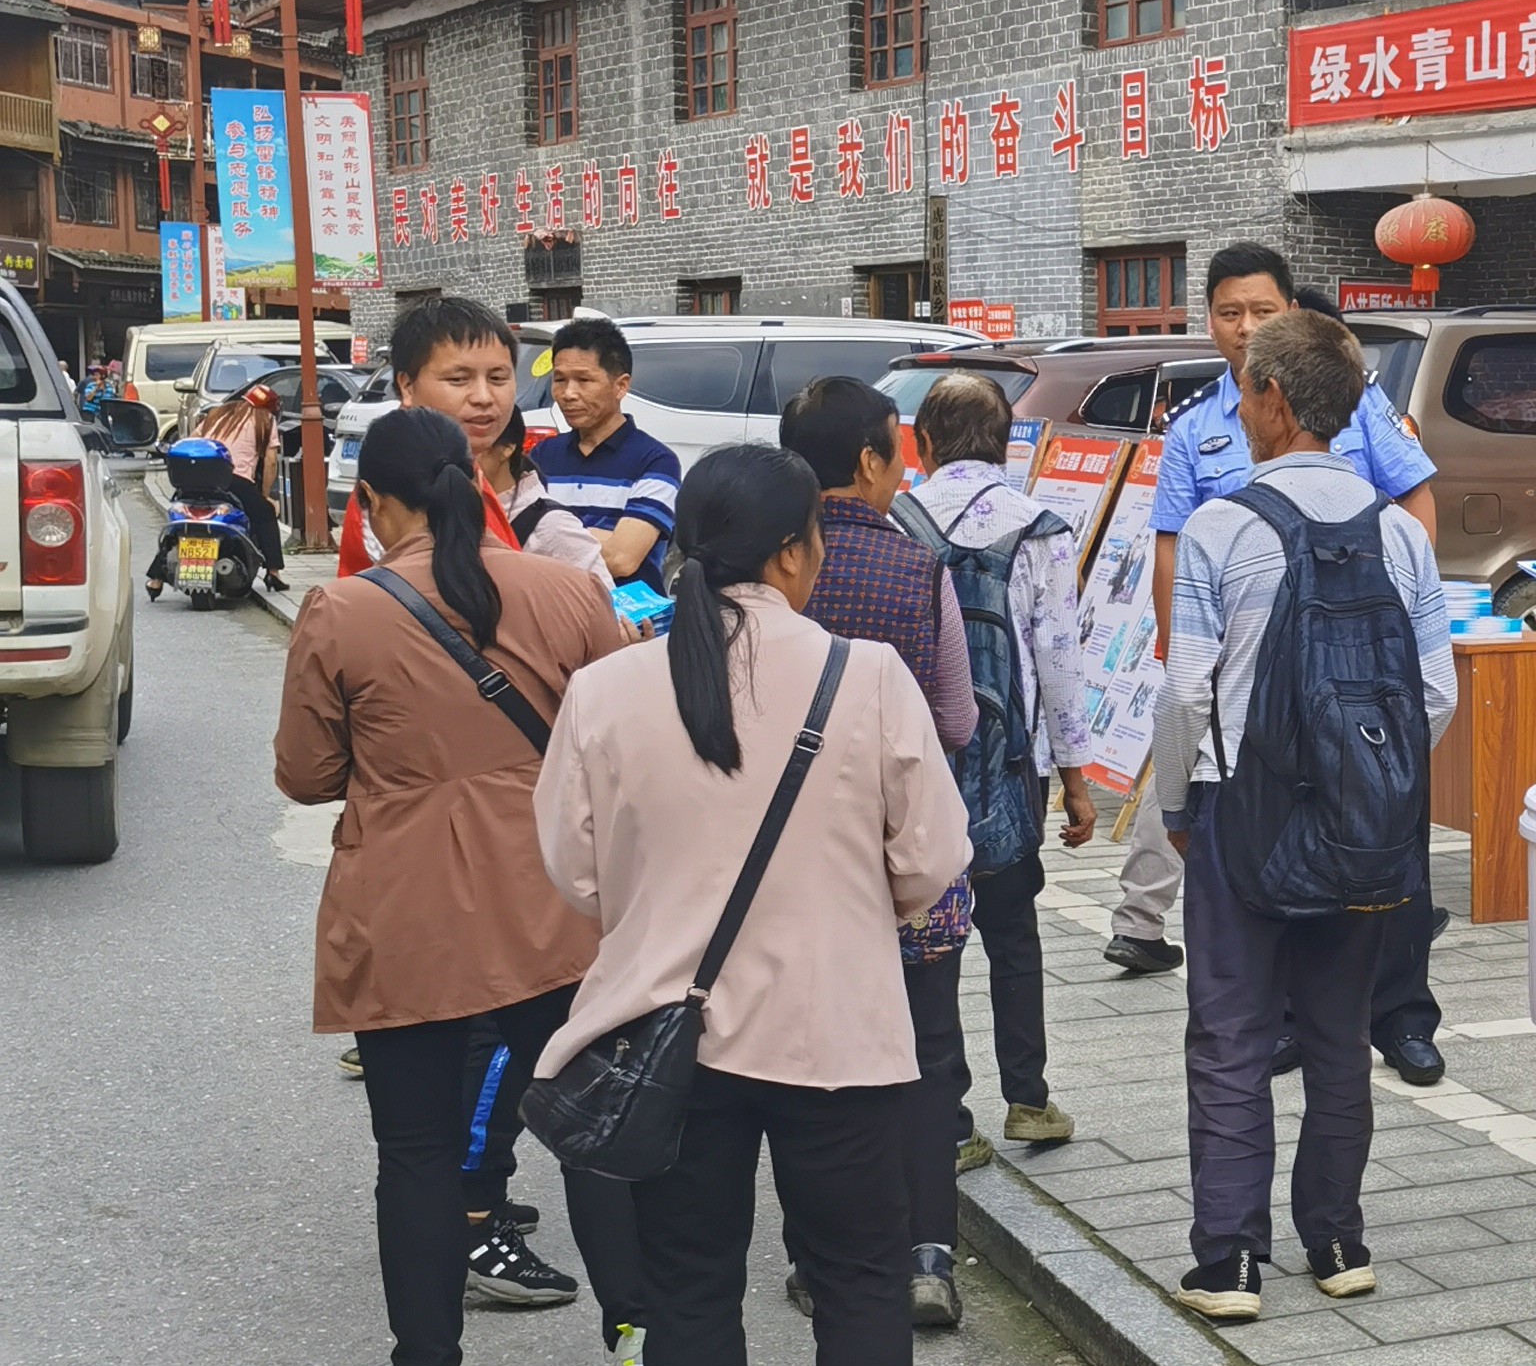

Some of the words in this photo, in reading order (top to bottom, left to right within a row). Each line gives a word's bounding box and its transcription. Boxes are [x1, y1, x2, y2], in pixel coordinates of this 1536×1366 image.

[225, 121, 252, 238] 参与志愿服务
[253, 105, 279, 221] 弘扬雷锋精神
[315, 115, 339, 236] 文明和谐靠大家
[340, 115, 364, 236] 美丽虎形山是我家
[392, 149, 682, 246] 民对美好生活的向往
[746, 56, 1231, 211] 就是我们的奋斗目标
